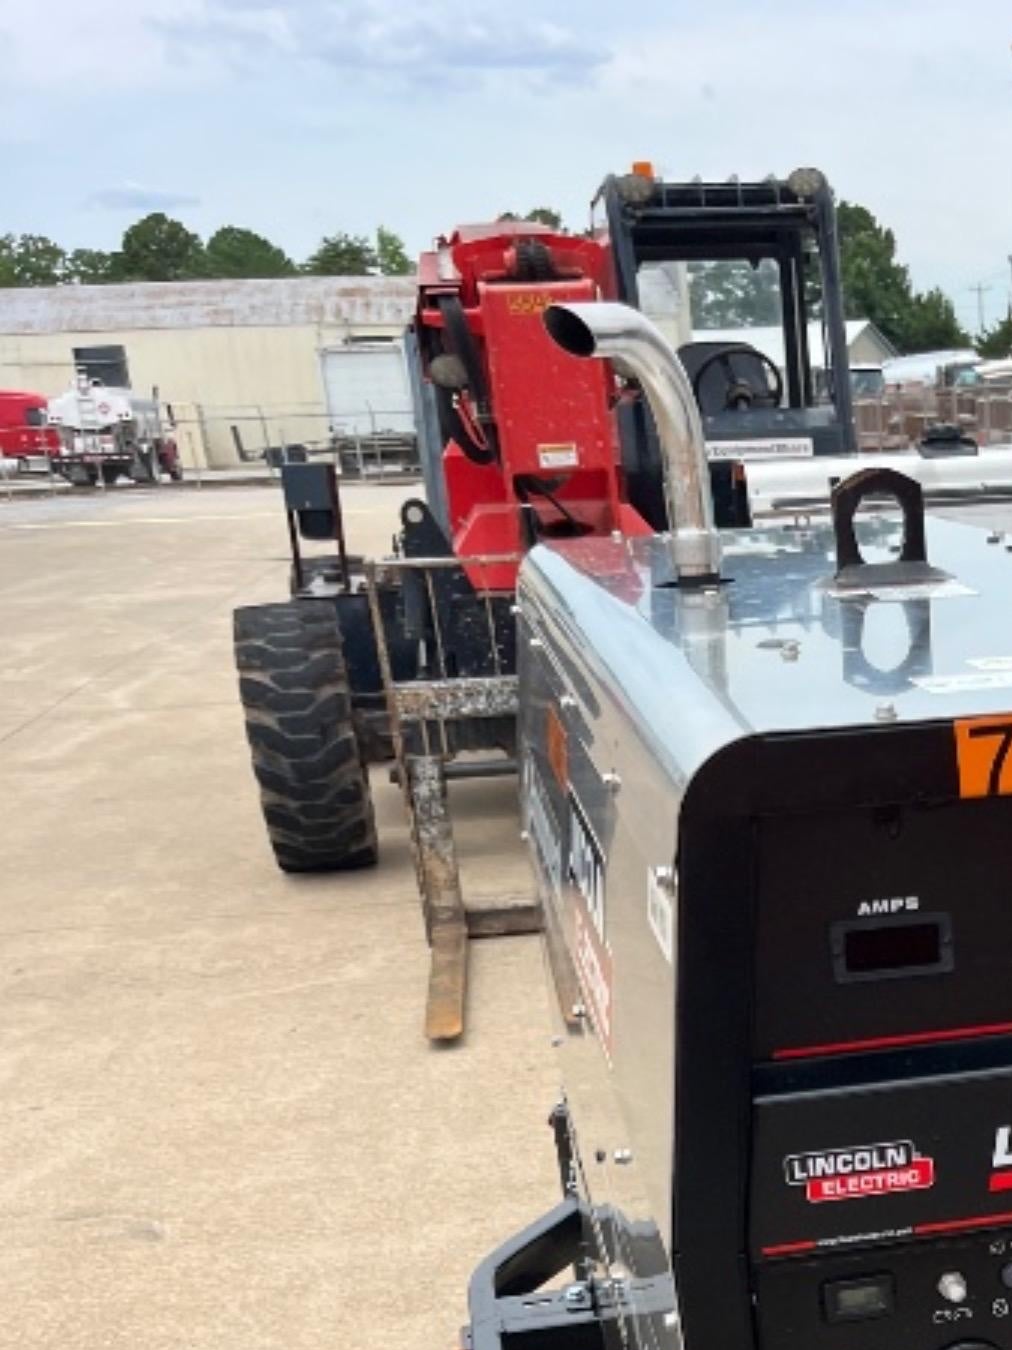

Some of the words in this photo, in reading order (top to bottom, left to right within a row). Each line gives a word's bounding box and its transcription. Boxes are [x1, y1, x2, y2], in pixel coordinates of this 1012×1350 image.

[857, 895, 919, 916] AMPS
[791, 1146, 908, 1181] LINCOLN
[820, 1169, 923, 1198] ELECTRIC
